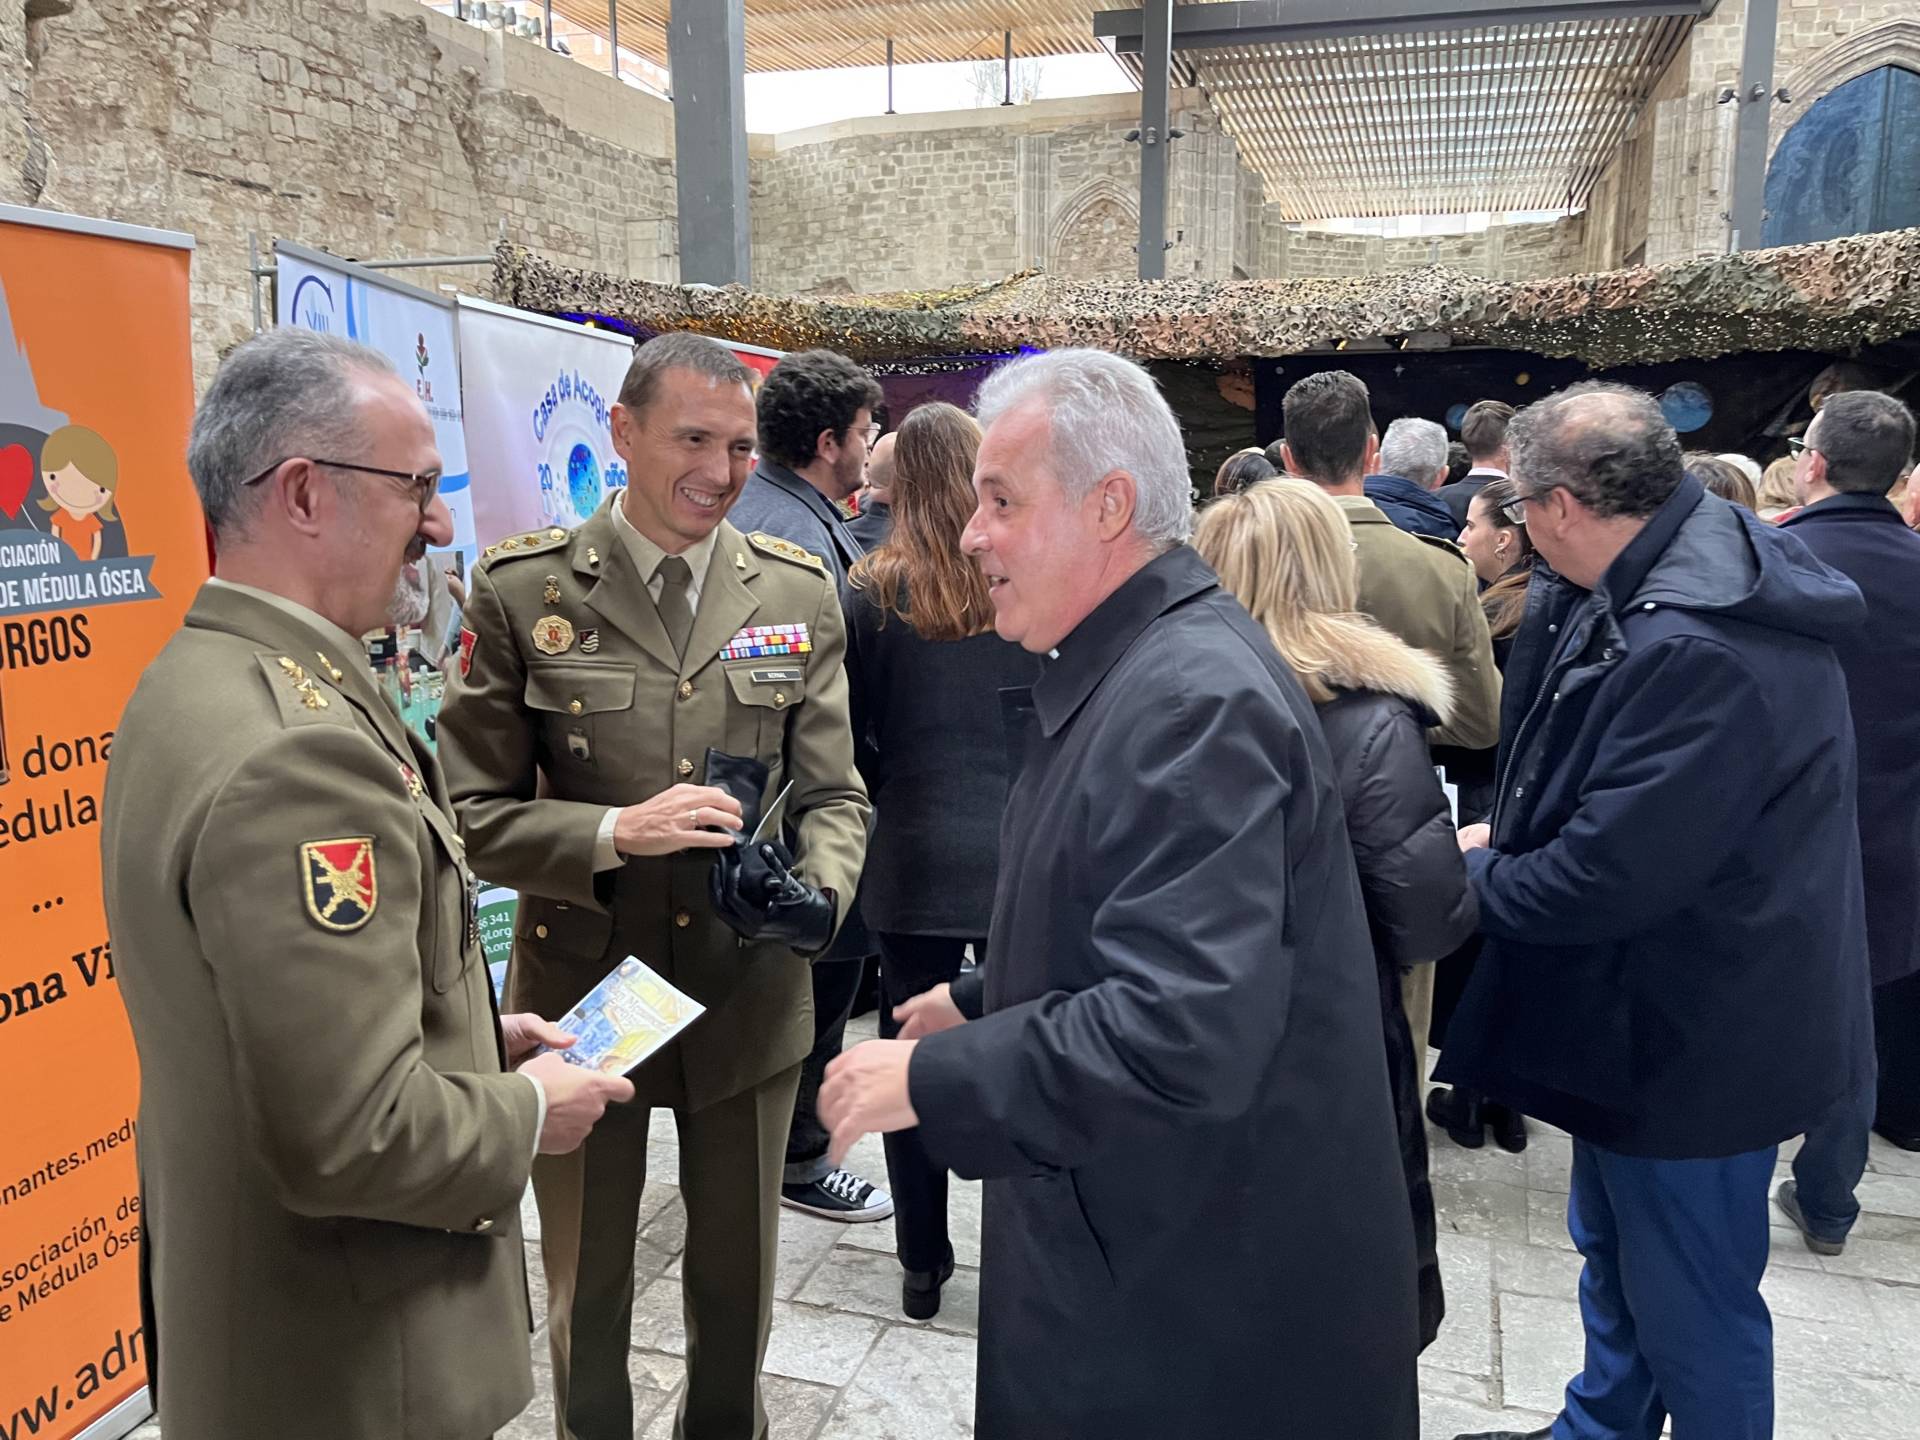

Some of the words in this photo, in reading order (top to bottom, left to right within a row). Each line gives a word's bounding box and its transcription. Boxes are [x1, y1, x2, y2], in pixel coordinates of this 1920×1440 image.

[533, 383, 558, 443] Casa
[558, 368, 572, 400] de
[537, 463, 553, 491] 20
[0, 539, 61, 568] CIACIÓN
[22, 572, 98, 606] MÉDULA
[100, 566, 146, 598] ÓSEA
[0, 613, 92, 671] RGOS
[489, 911, 512, 926] 341
[0, 1117, 136, 1206] nantes.med
[0, 1216, 107, 1292] sociación
[17, 1252, 99, 1312] Médula
